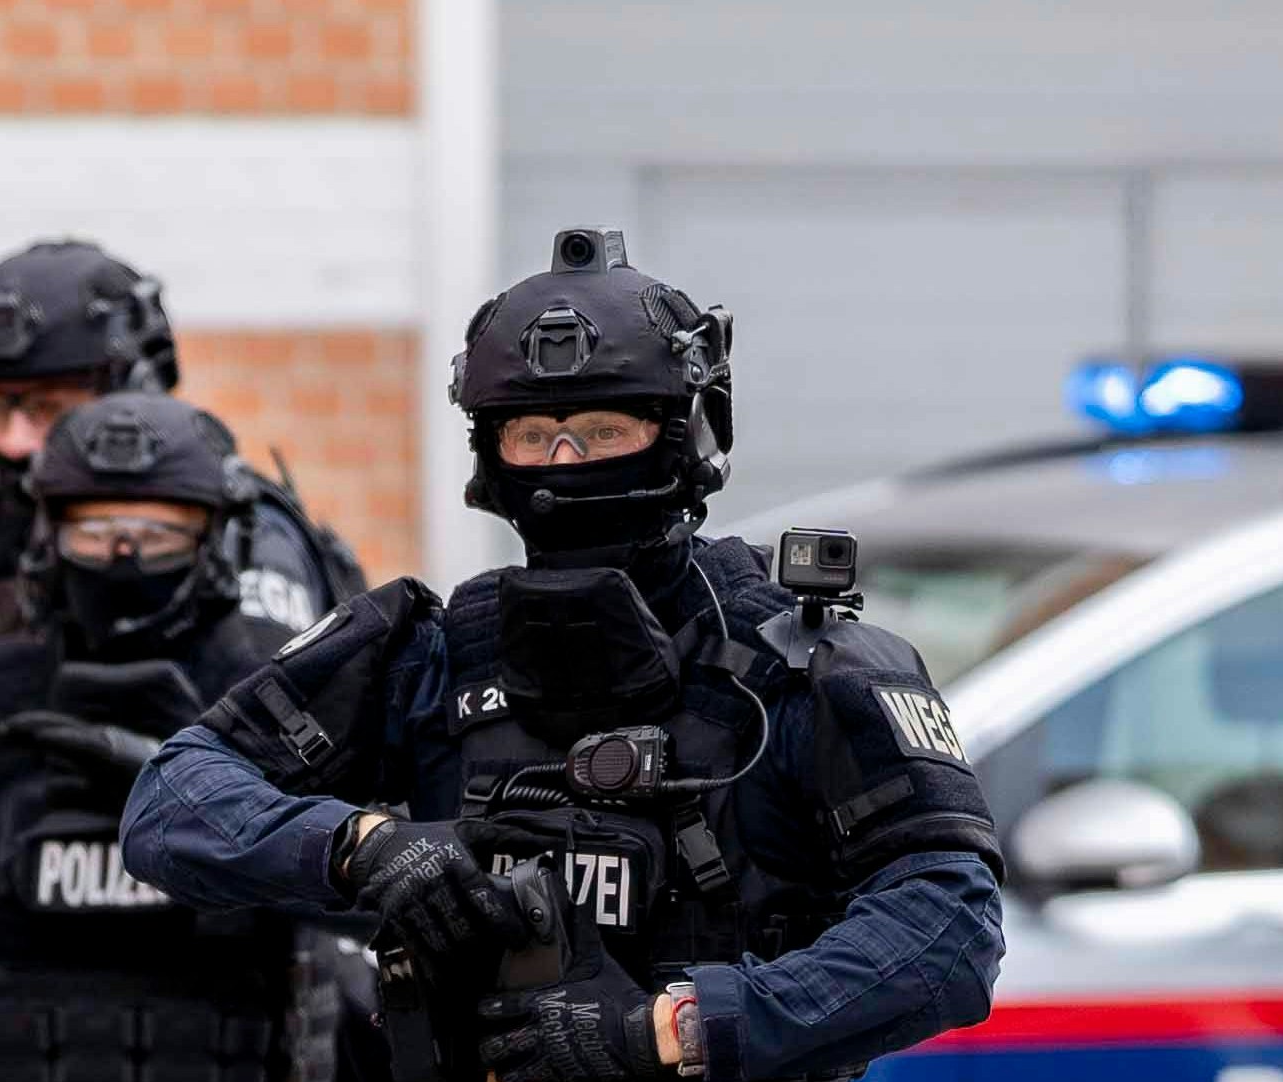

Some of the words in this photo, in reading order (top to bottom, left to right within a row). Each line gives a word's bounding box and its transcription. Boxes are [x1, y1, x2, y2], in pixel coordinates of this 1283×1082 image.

[239, 569, 318, 632] EGA
[458, 692, 472, 719] K
[880, 691, 972, 766] WEG
